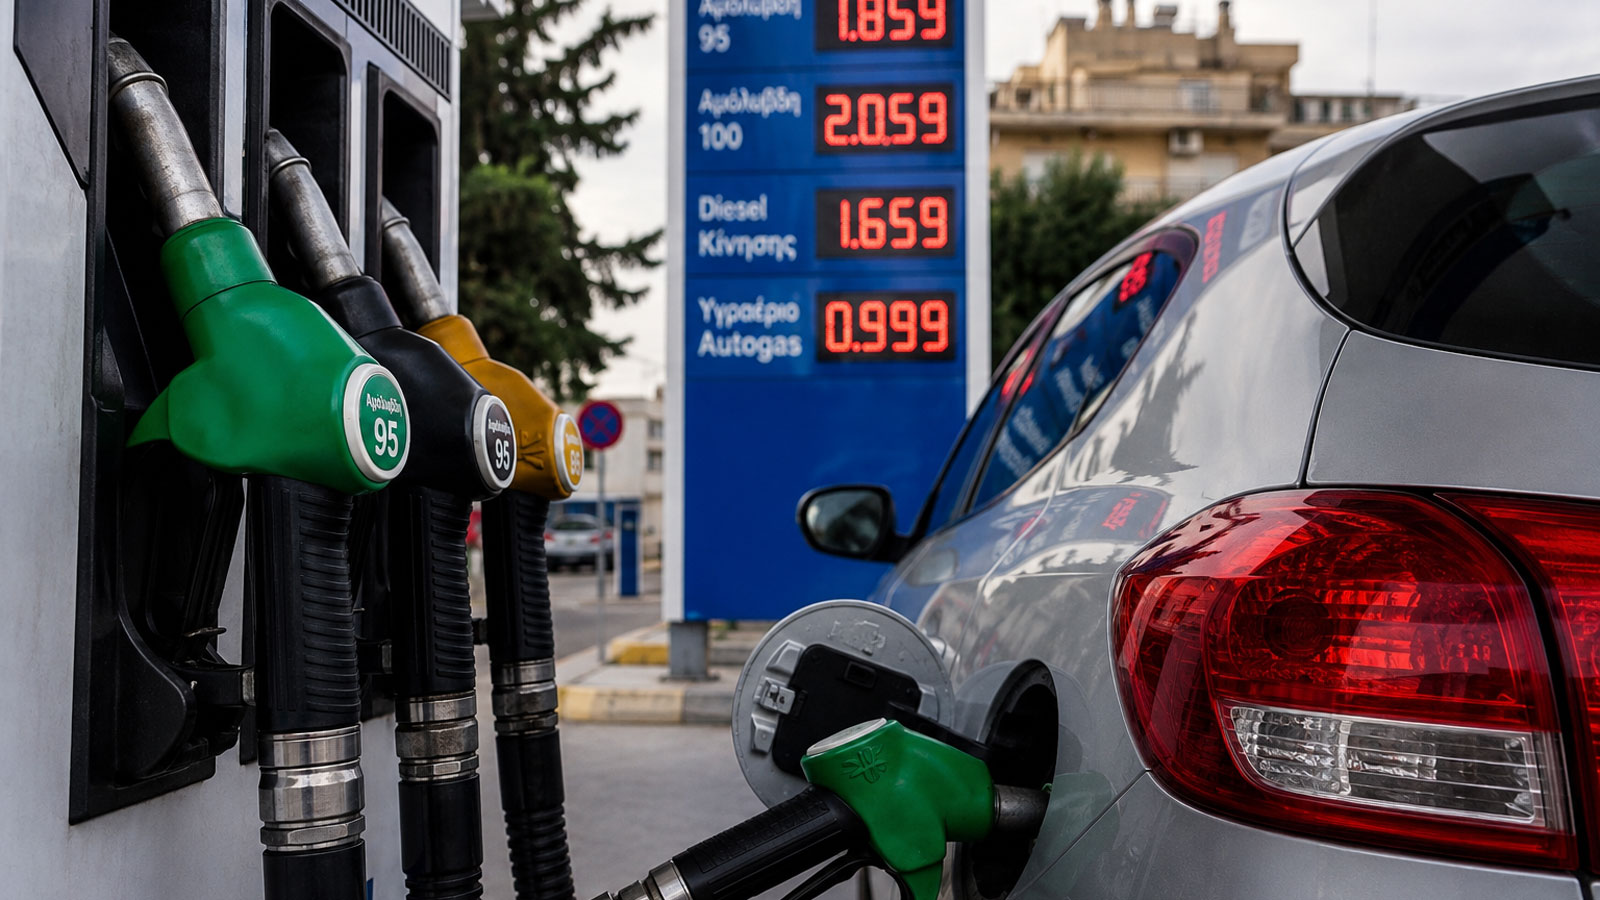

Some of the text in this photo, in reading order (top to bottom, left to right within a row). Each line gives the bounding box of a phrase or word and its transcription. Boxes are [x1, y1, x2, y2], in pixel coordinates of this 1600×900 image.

[698, 23, 731, 53] 95
[837, 0, 947, 42] 1.859
[698, 121, 743, 151] 100
[698, 193, 768, 222] Diesel
[840, 196, 948, 250] 1.659
[698, 228, 797, 262] Κίνησης
[697, 295, 801, 329] Υγραέριο
[825, 300, 949, 353] 0.999
[697, 329, 803, 363] Autogas
[374, 417, 399, 458] 95
[495, 438, 511, 471] 95
